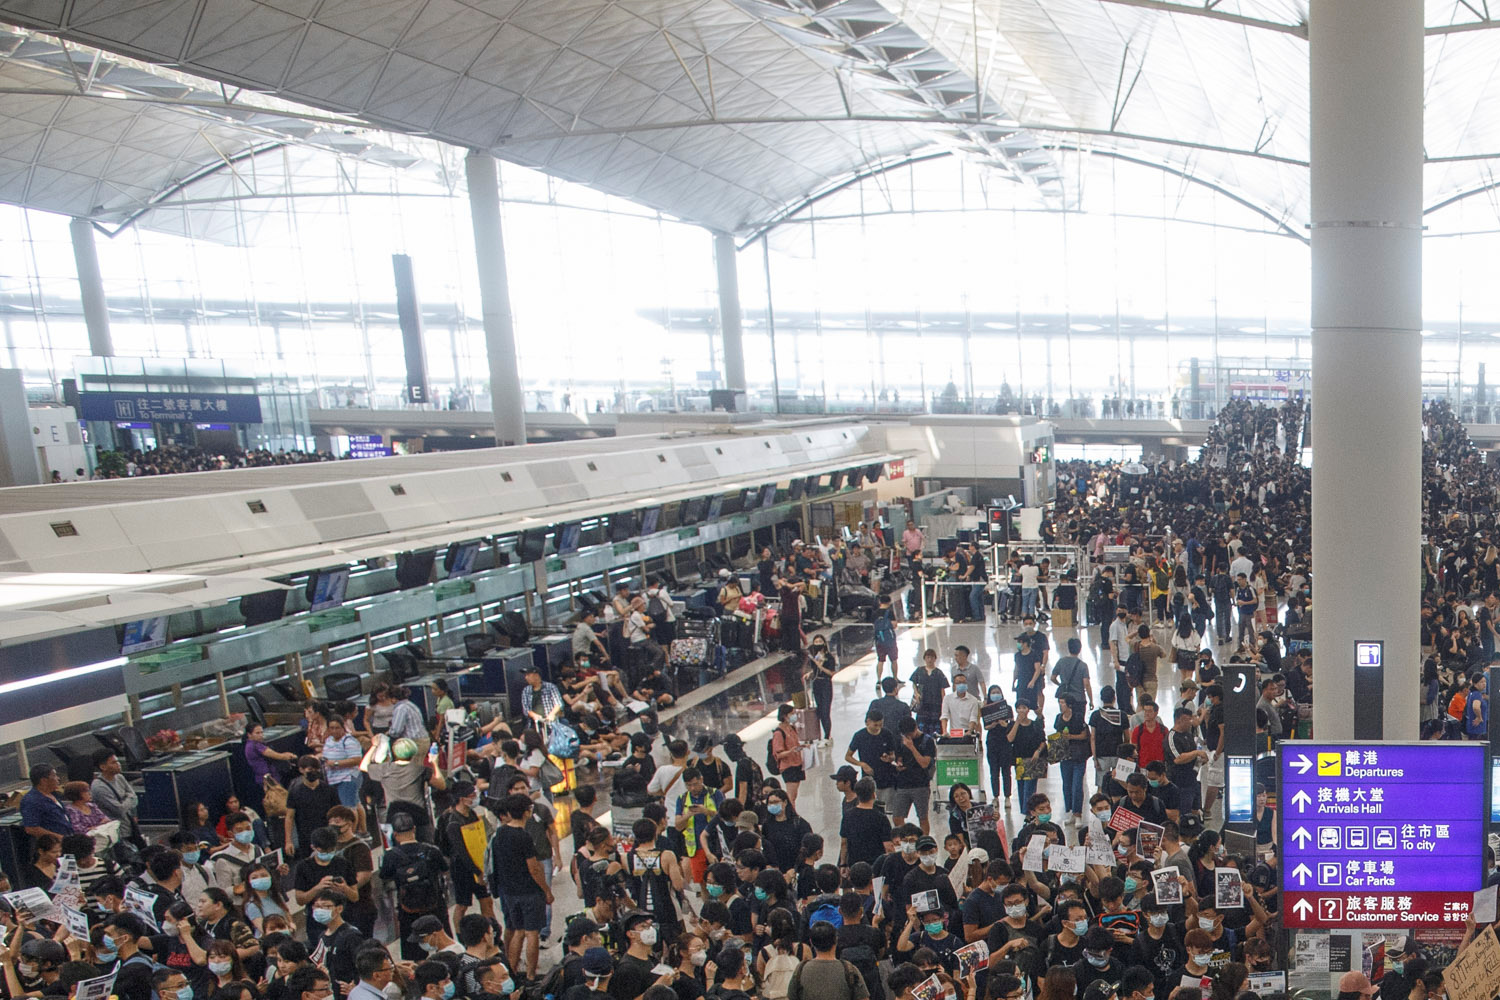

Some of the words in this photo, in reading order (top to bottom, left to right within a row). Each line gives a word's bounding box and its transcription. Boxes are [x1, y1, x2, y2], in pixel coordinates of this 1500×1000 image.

[412, 386, 421, 398] E
[138, 410, 149, 419] To
[150, 411, 186, 420] Terminal
[188, 412, 192, 420] 2
[52, 426, 60, 442] E
[1346, 750, 1378, 765] 離港
[1345, 767, 1404, 778] Departures
[1318, 788, 1384, 802] 接機大堂
[1318, 803, 1359, 814] Arrivals
[1362, 803, 1382, 814] Hall
[1401, 824, 1450, 839] 往市區
[1400, 840, 1414, 850] To
[1416, 840, 1436, 852] city
[1346, 861, 1395, 876] 停車場
[1346, 876, 1364, 886] Car
[1367, 876, 1395, 886] Parks
[1346, 896, 1412, 911] 旅客服務
[1444, 902, 1469, 911] ご案内
[1346, 912, 1398, 922] Customer
[1400, 912, 1439, 922] Service
